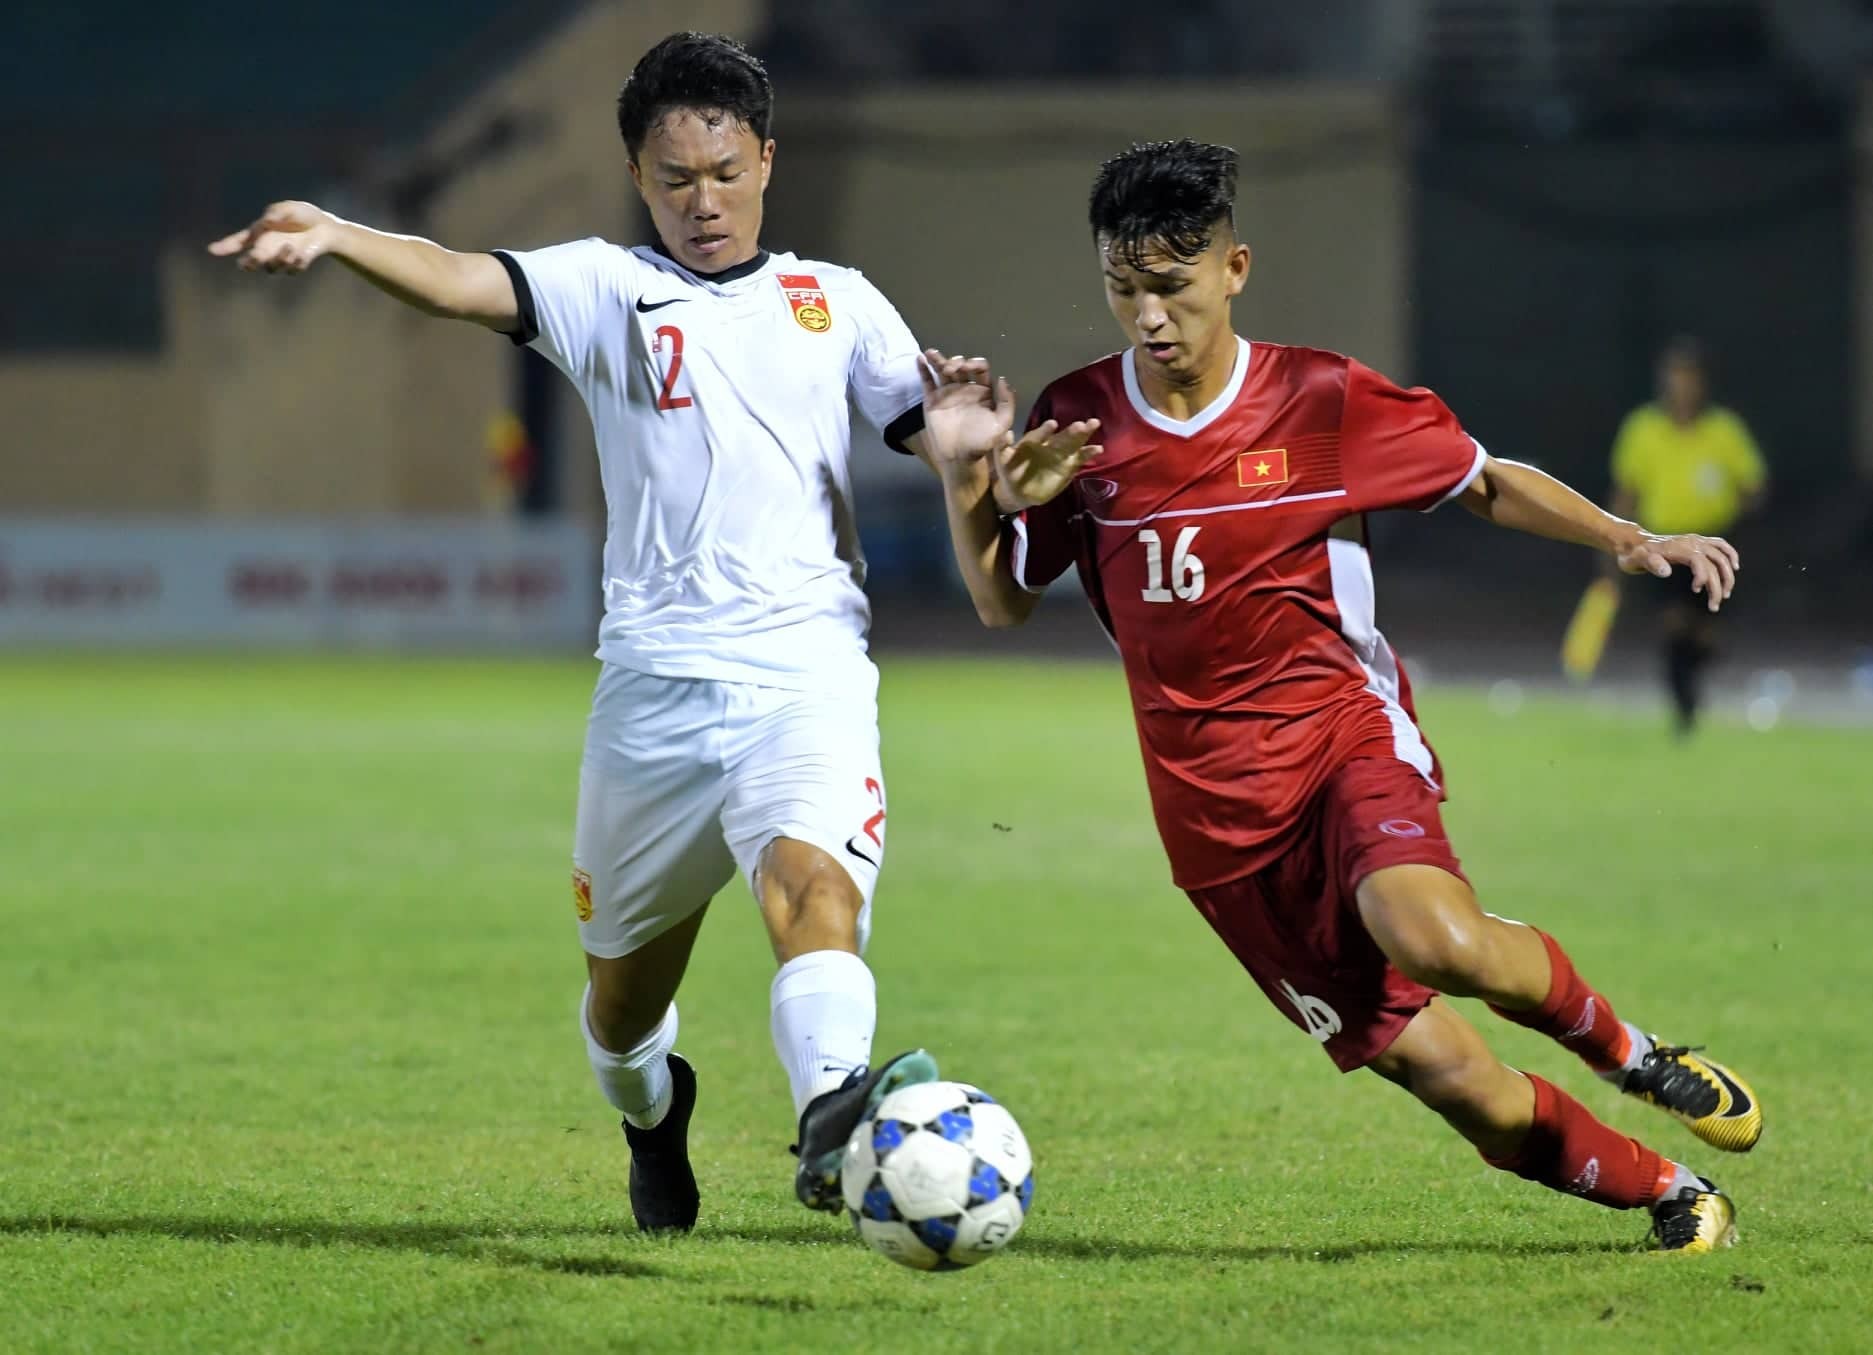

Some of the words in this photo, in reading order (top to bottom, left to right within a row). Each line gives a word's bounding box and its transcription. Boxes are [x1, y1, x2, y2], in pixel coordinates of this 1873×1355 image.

[787, 291, 824, 301] CFA
[653, 325, 692, 410] 2
[1138, 526, 1205, 603] 16
[863, 777, 886, 848] 2
